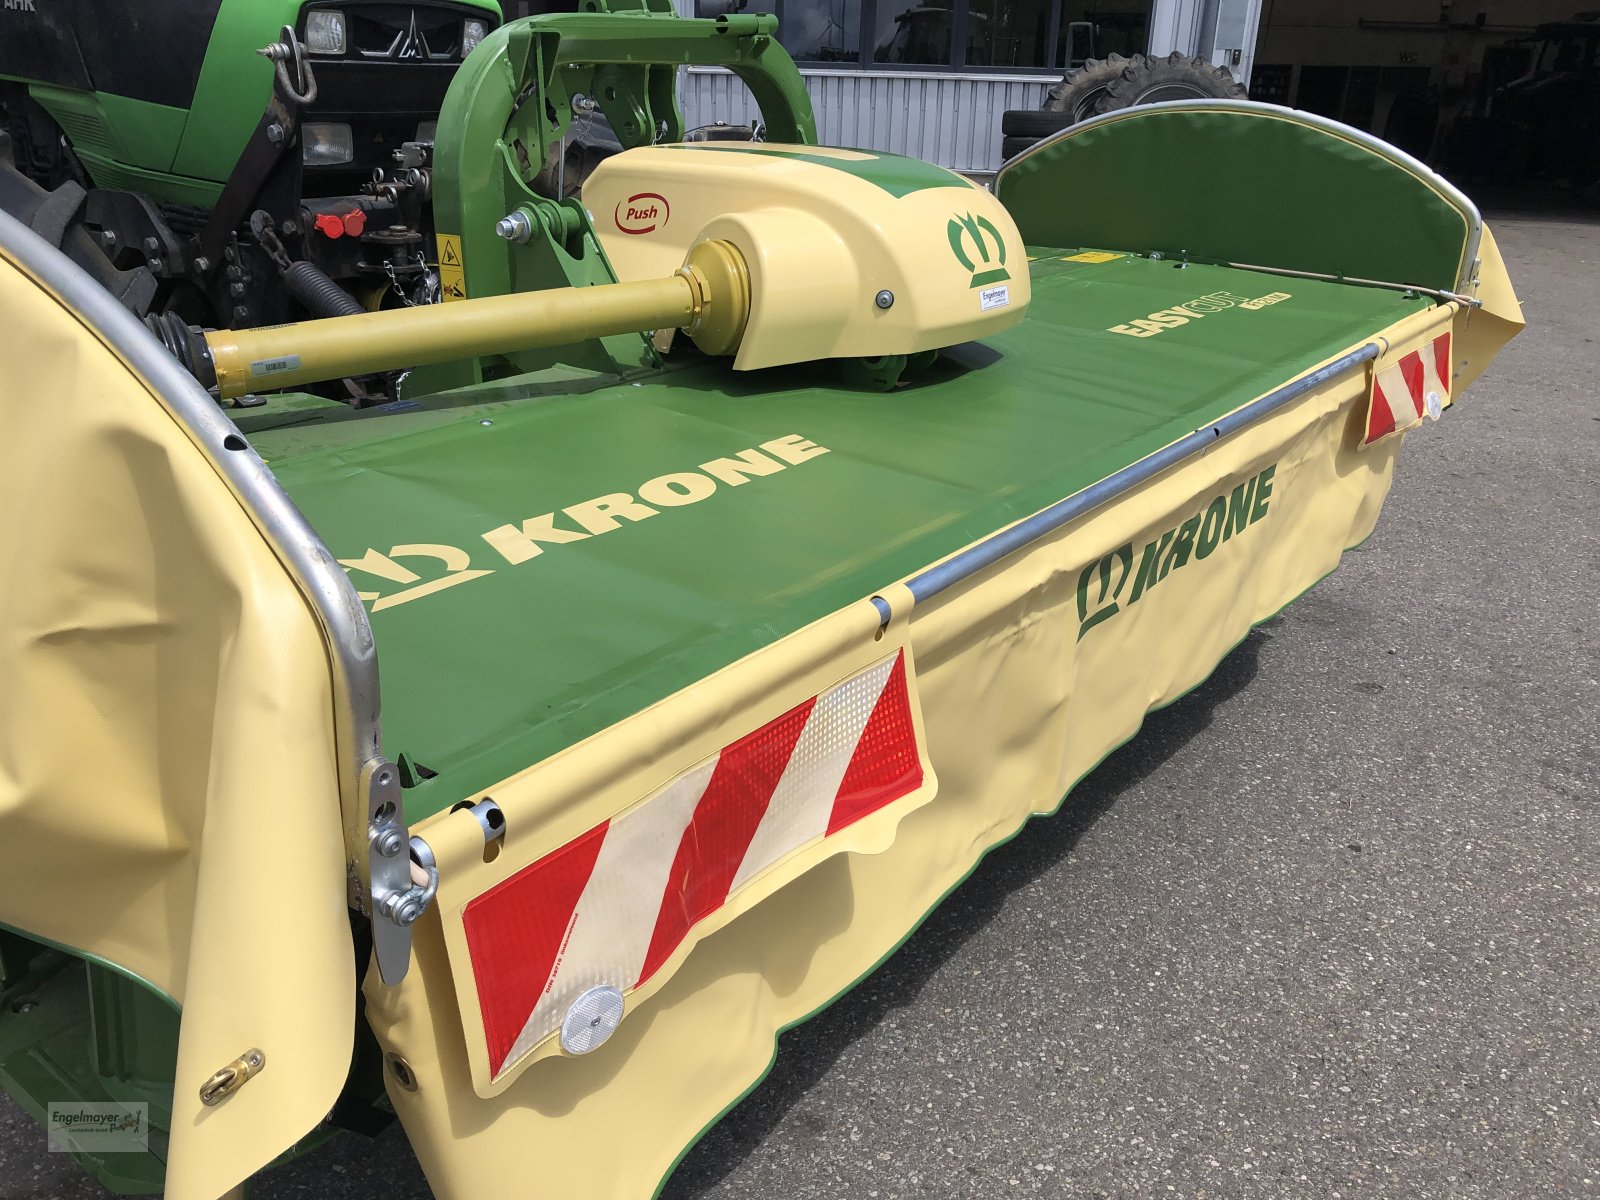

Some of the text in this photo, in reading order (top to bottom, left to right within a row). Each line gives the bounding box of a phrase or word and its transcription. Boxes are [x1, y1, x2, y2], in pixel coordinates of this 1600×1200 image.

[1399, 51, 1418, 62] WC
[626, 205, 658, 220] Push
[480, 433, 832, 565] KRONE
[1127, 463, 1277, 606] KRONE
[545, 979, 554, 994] DIN
